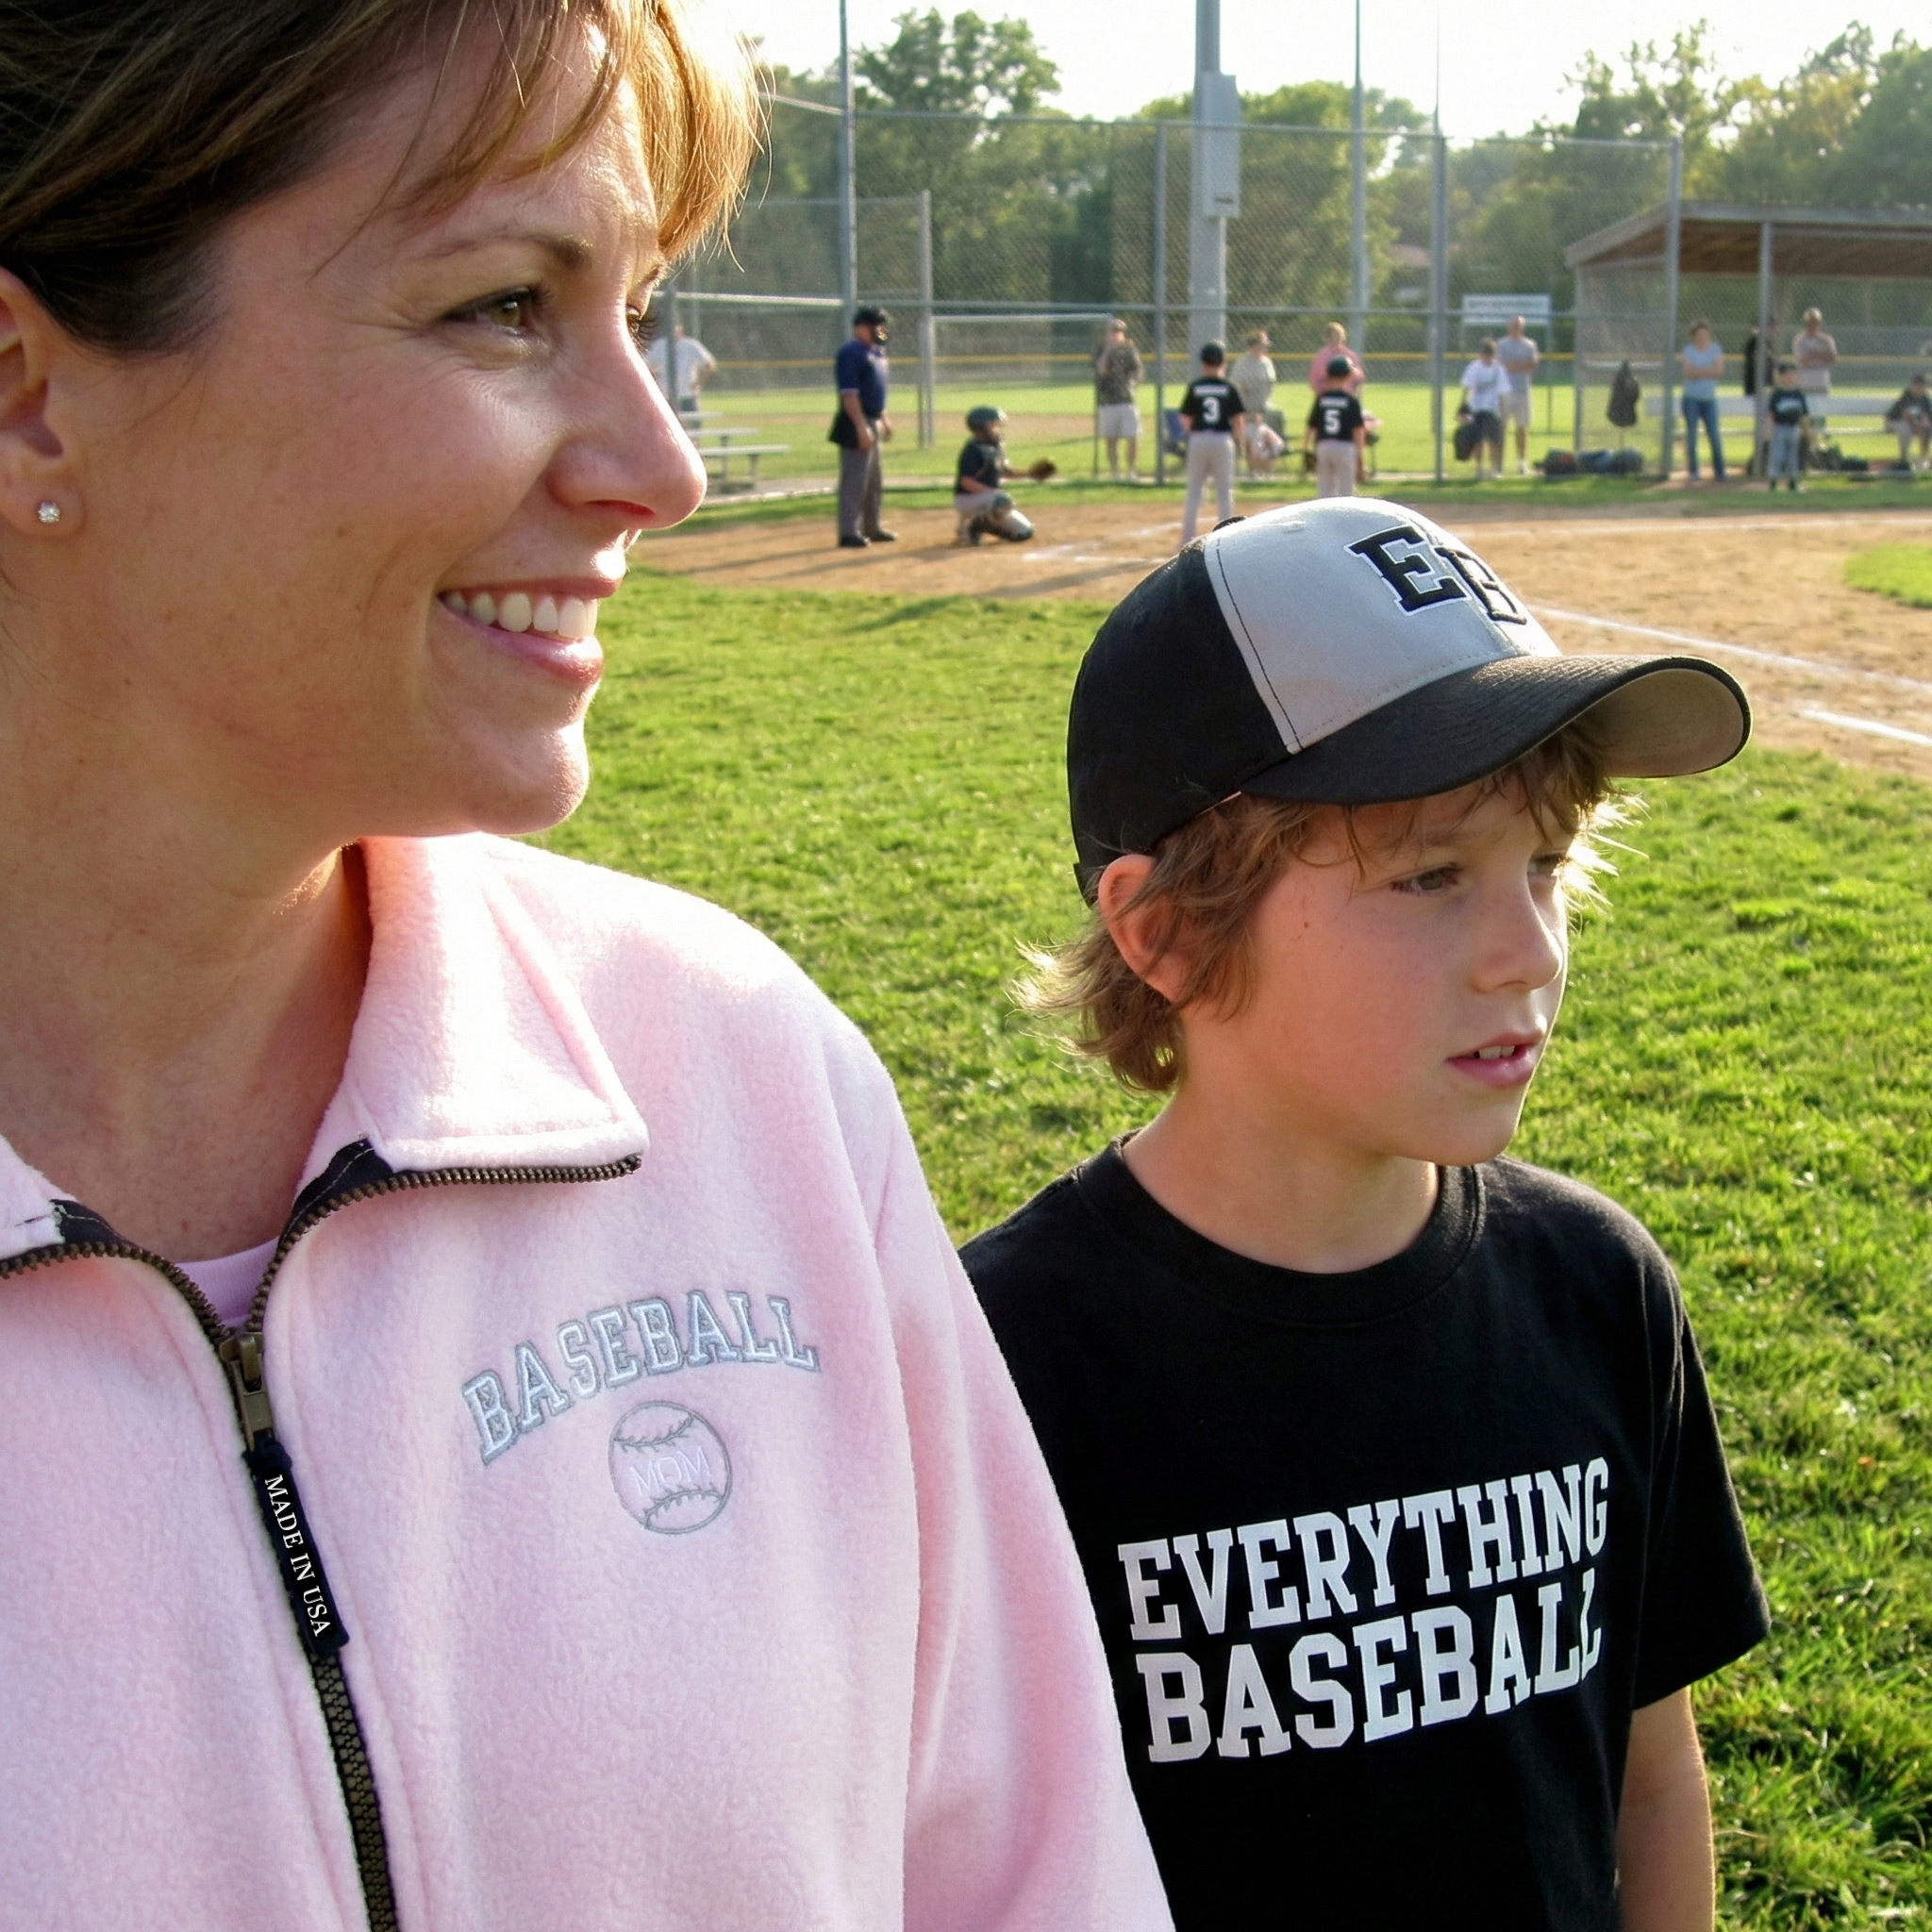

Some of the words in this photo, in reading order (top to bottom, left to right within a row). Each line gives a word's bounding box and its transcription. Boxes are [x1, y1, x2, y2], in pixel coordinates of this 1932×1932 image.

[1202, 396, 1221, 424] 3
[1324, 408, 1341, 434] 5
[461, 1290, 821, 1466] BASEBALL
[629, 1445, 711, 1496] MOM
[1118, 1457, 1608, 1641] EVERYTHING
[265, 1474, 304, 1548] MADE
[291, 1553, 315, 1581] IN
[303, 1586, 331, 1637] USA
[1135, 1568, 1602, 1763] BASEBALL
